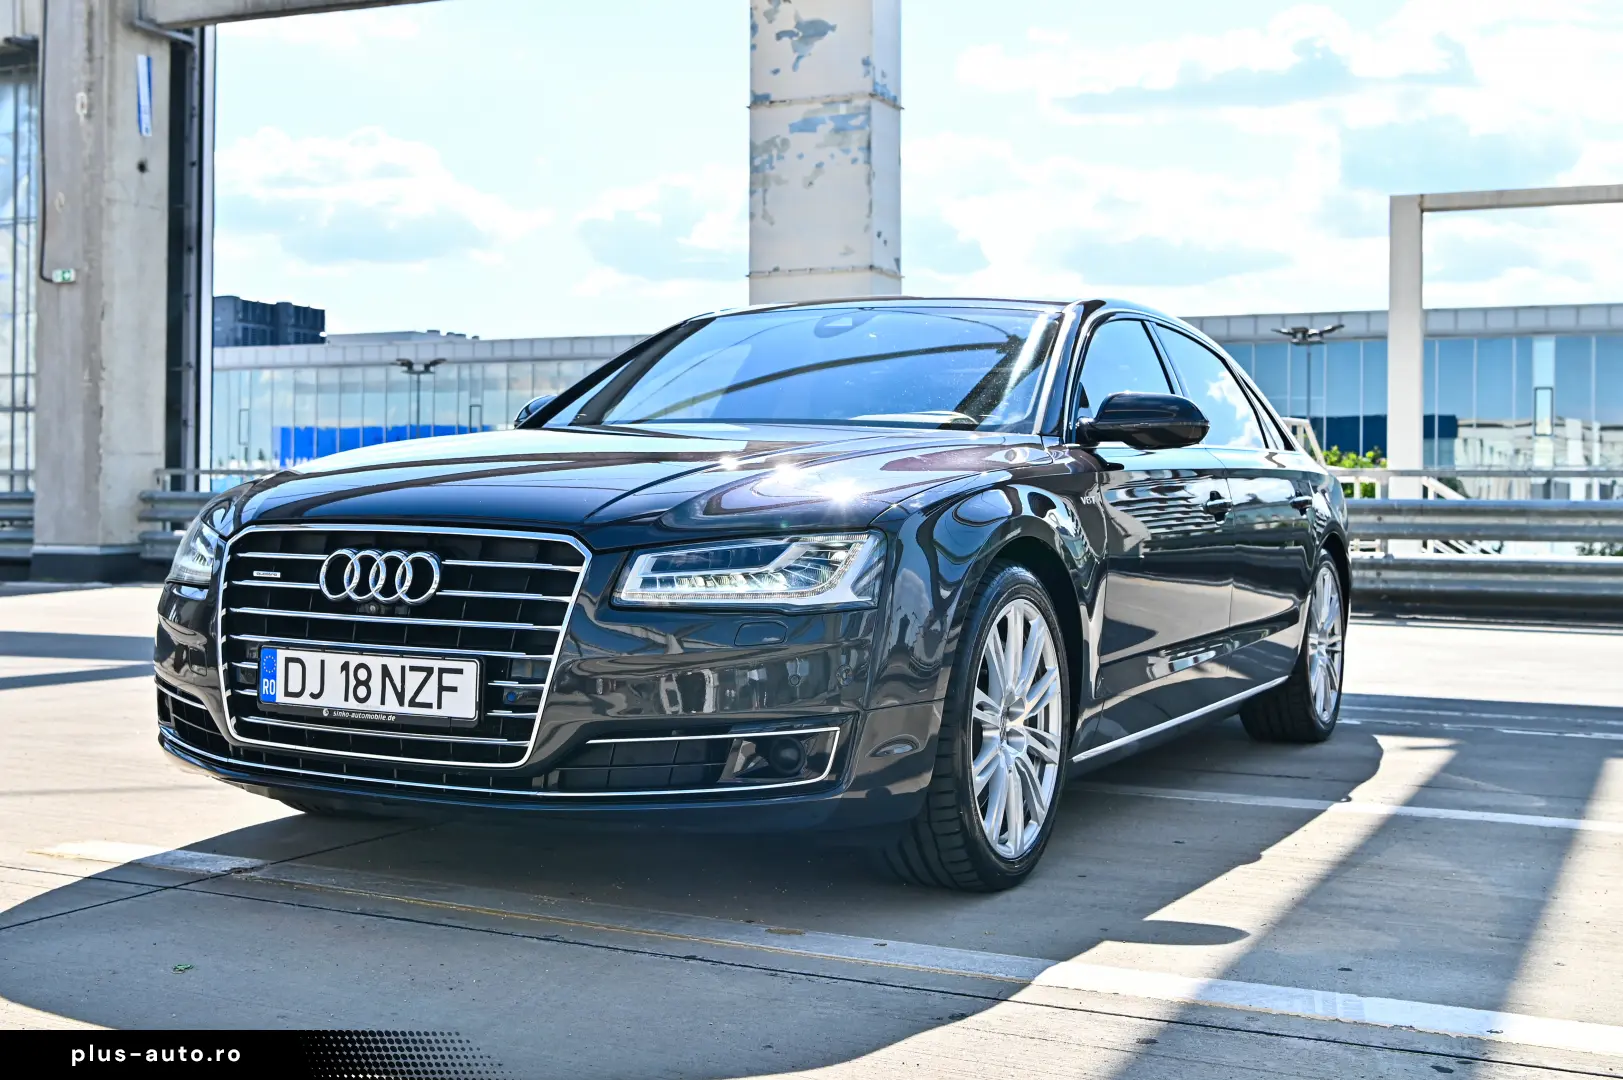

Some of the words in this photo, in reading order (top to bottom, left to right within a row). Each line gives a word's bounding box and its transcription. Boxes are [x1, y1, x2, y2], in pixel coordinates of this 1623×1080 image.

[262, 678, 276, 696] RO
[284, 656, 325, 700] DJ
[340, 660, 372, 704] 18
[380, 663, 464, 710] NZF
